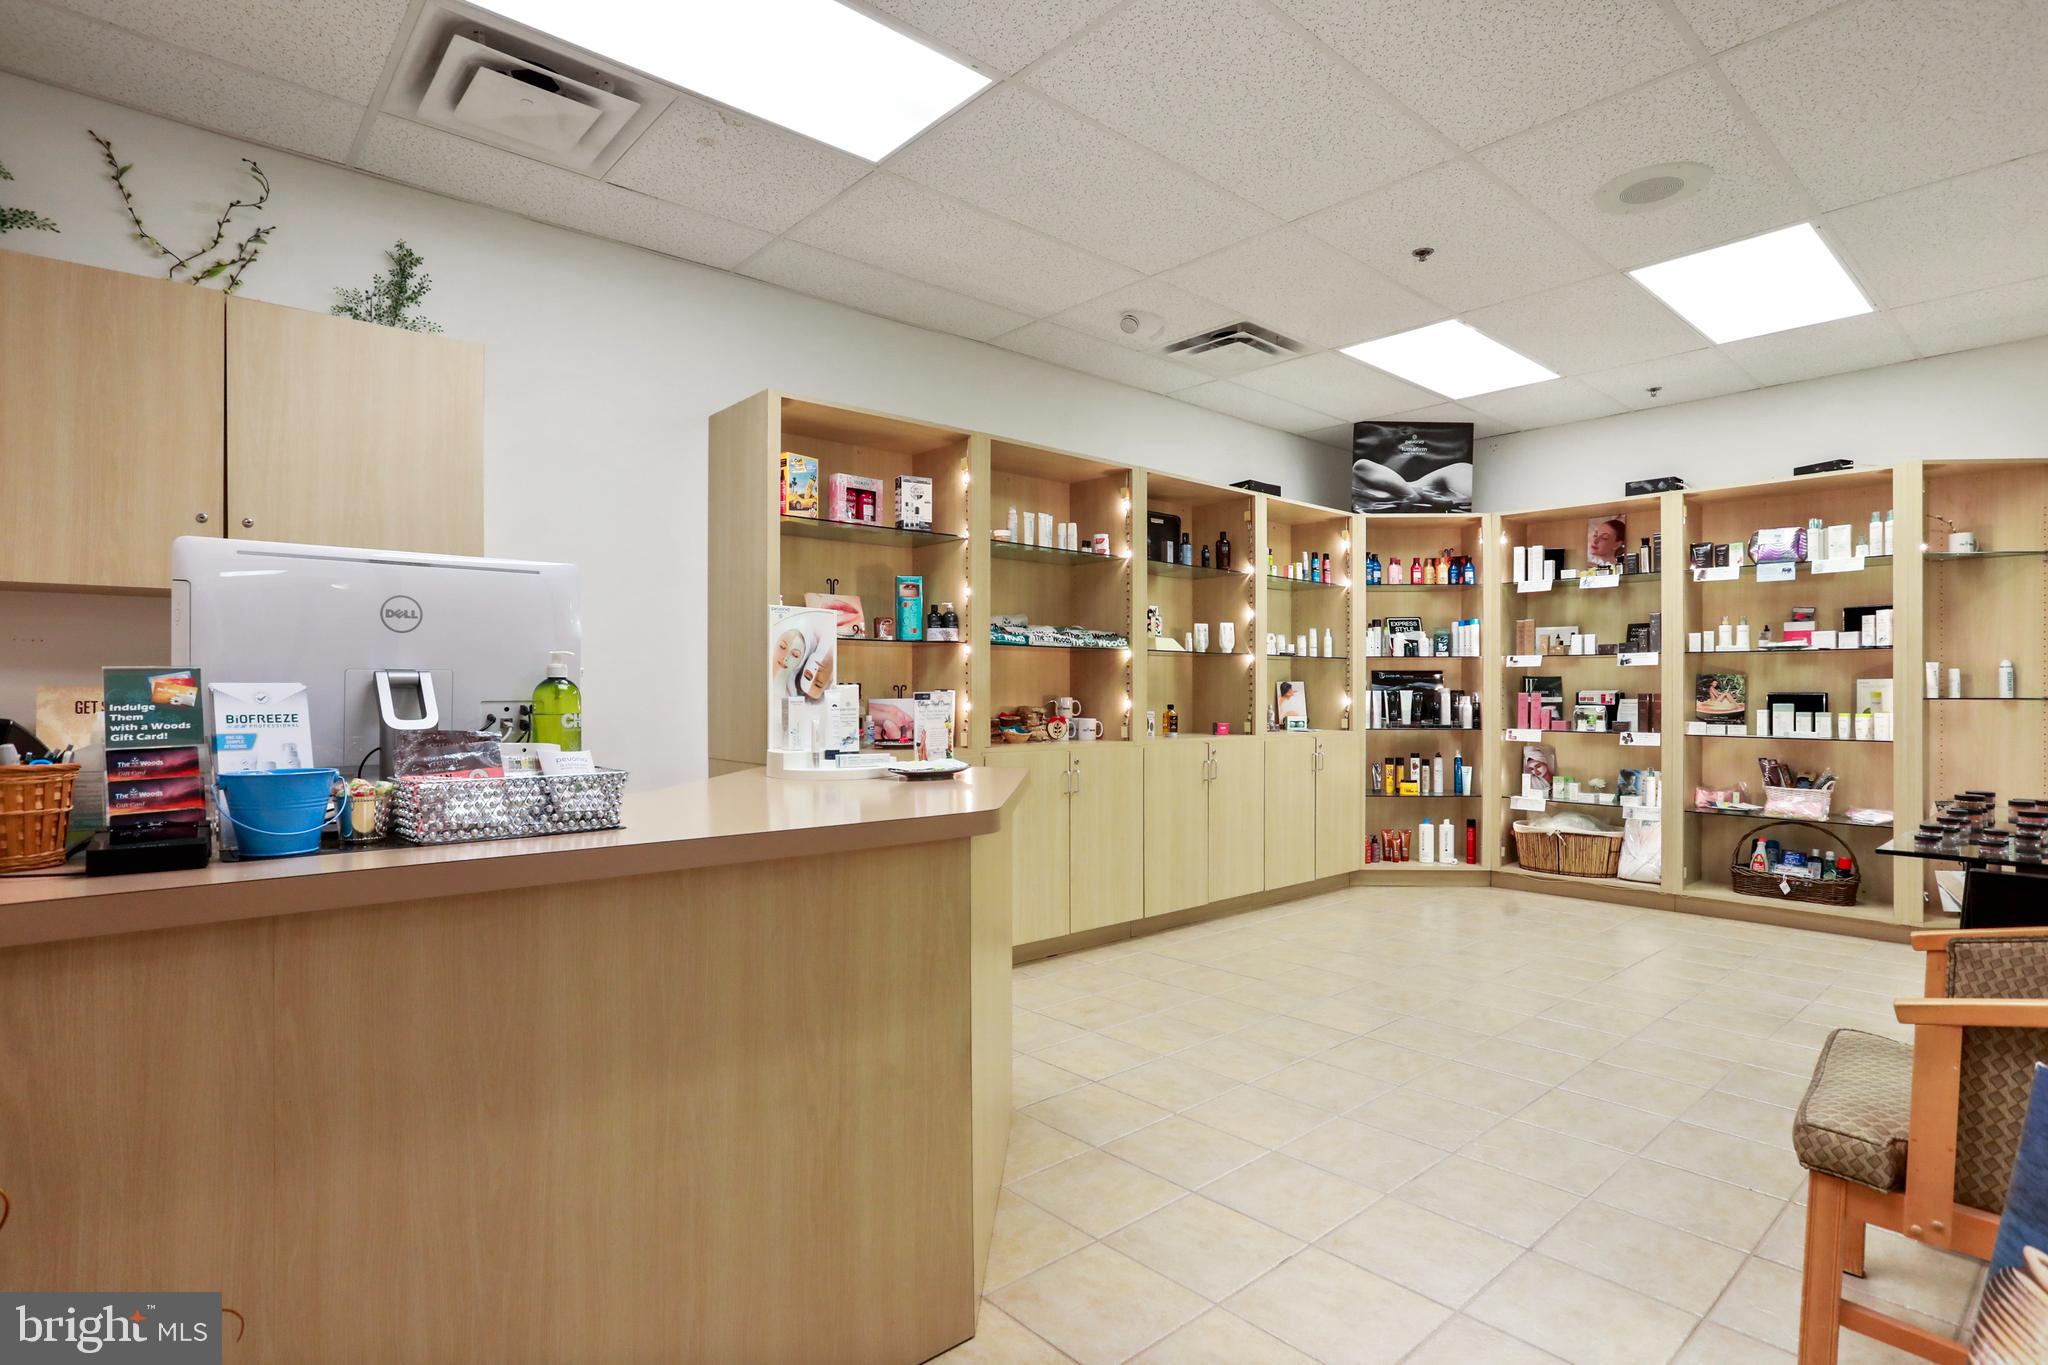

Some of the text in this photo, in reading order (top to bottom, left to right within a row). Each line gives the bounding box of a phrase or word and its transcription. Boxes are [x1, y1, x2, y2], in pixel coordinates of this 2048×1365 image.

[385, 609, 418, 619] DELL
[75, 700, 98, 714] GET
[109, 703, 155, 712] Indulge
[110, 723, 138, 731] with
[151, 722, 191, 730] Woods
[110, 732, 168, 741] Gift Card!
[140, 759, 164, 767] Woods
[139, 790, 164, 798] Woods
